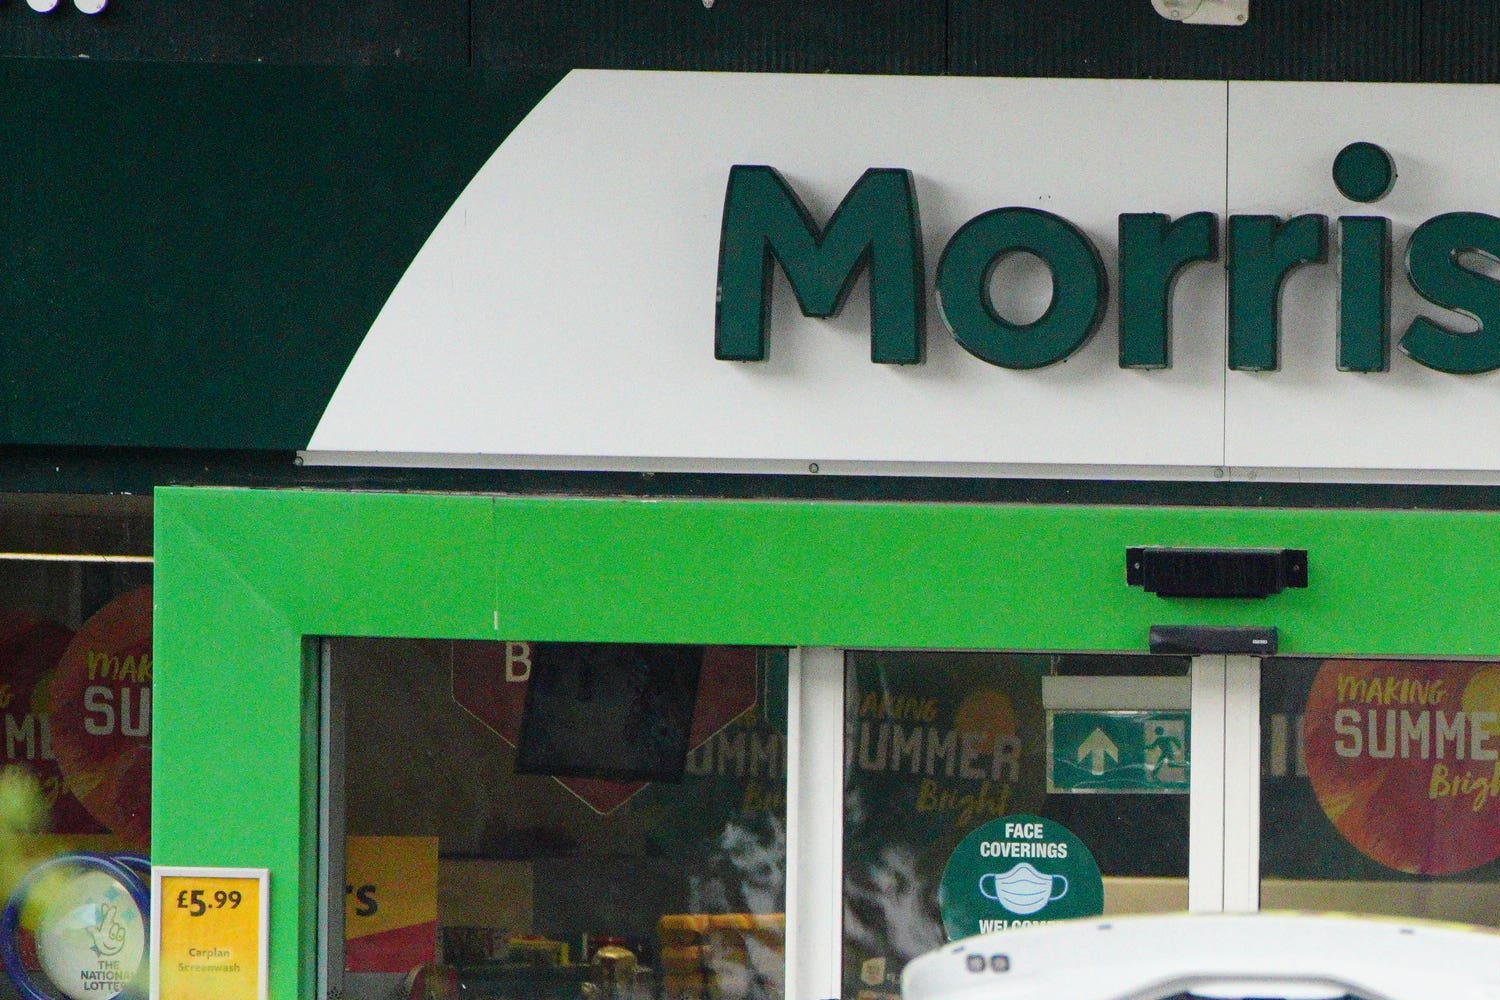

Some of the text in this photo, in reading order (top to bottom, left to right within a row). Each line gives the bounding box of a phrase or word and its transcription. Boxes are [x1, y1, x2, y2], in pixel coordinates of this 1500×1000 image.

[1005, 823, 1044, 839] FACE
[979, 842, 1068, 859] COVERINGS
[177, 889, 242, 917] £5.99
[188, 947, 230, 960] Carplan
[97, 960, 120, 970] THE
